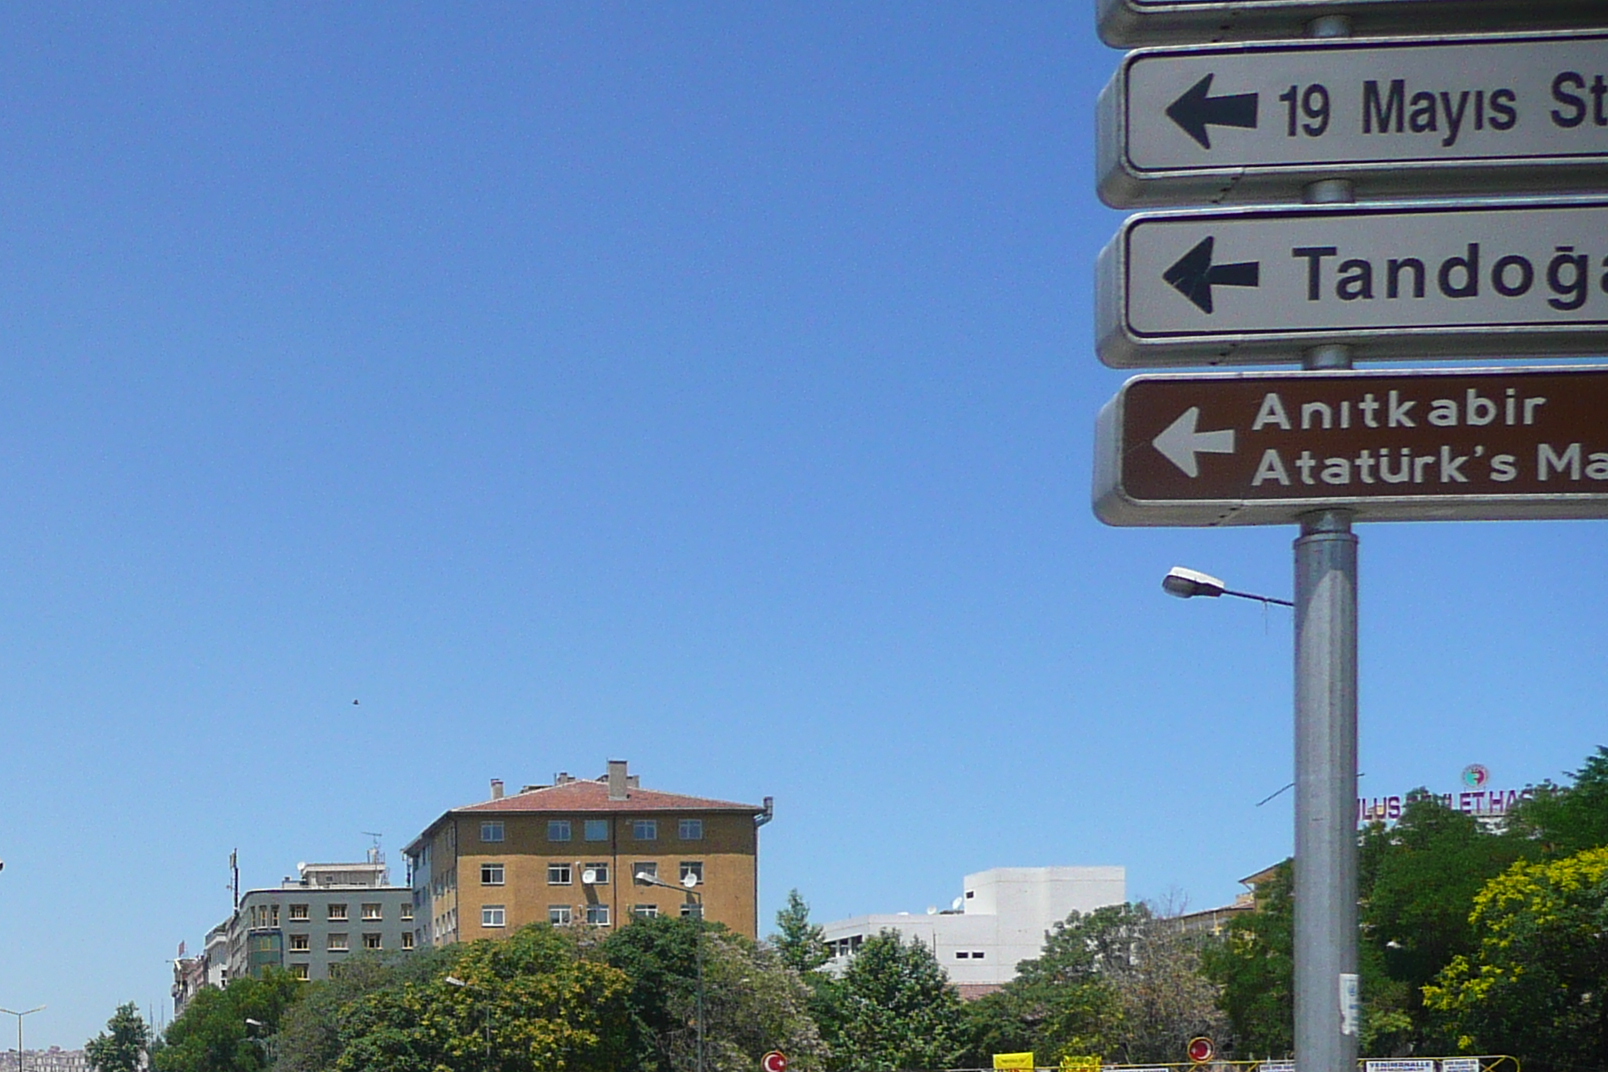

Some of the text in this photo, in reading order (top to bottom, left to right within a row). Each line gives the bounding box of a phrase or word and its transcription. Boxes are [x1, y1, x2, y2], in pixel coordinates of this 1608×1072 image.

[1279, 83, 1330, 138] 19
[1361, 79, 1517, 146] Mayıs
[1292, 243, 1608, 311] Tandoğ
[1252, 388, 1548, 431] Anıtkabir
[1251, 444, 1517, 487] Atatürk's
[1357, 796, 1401, 820] LUS
